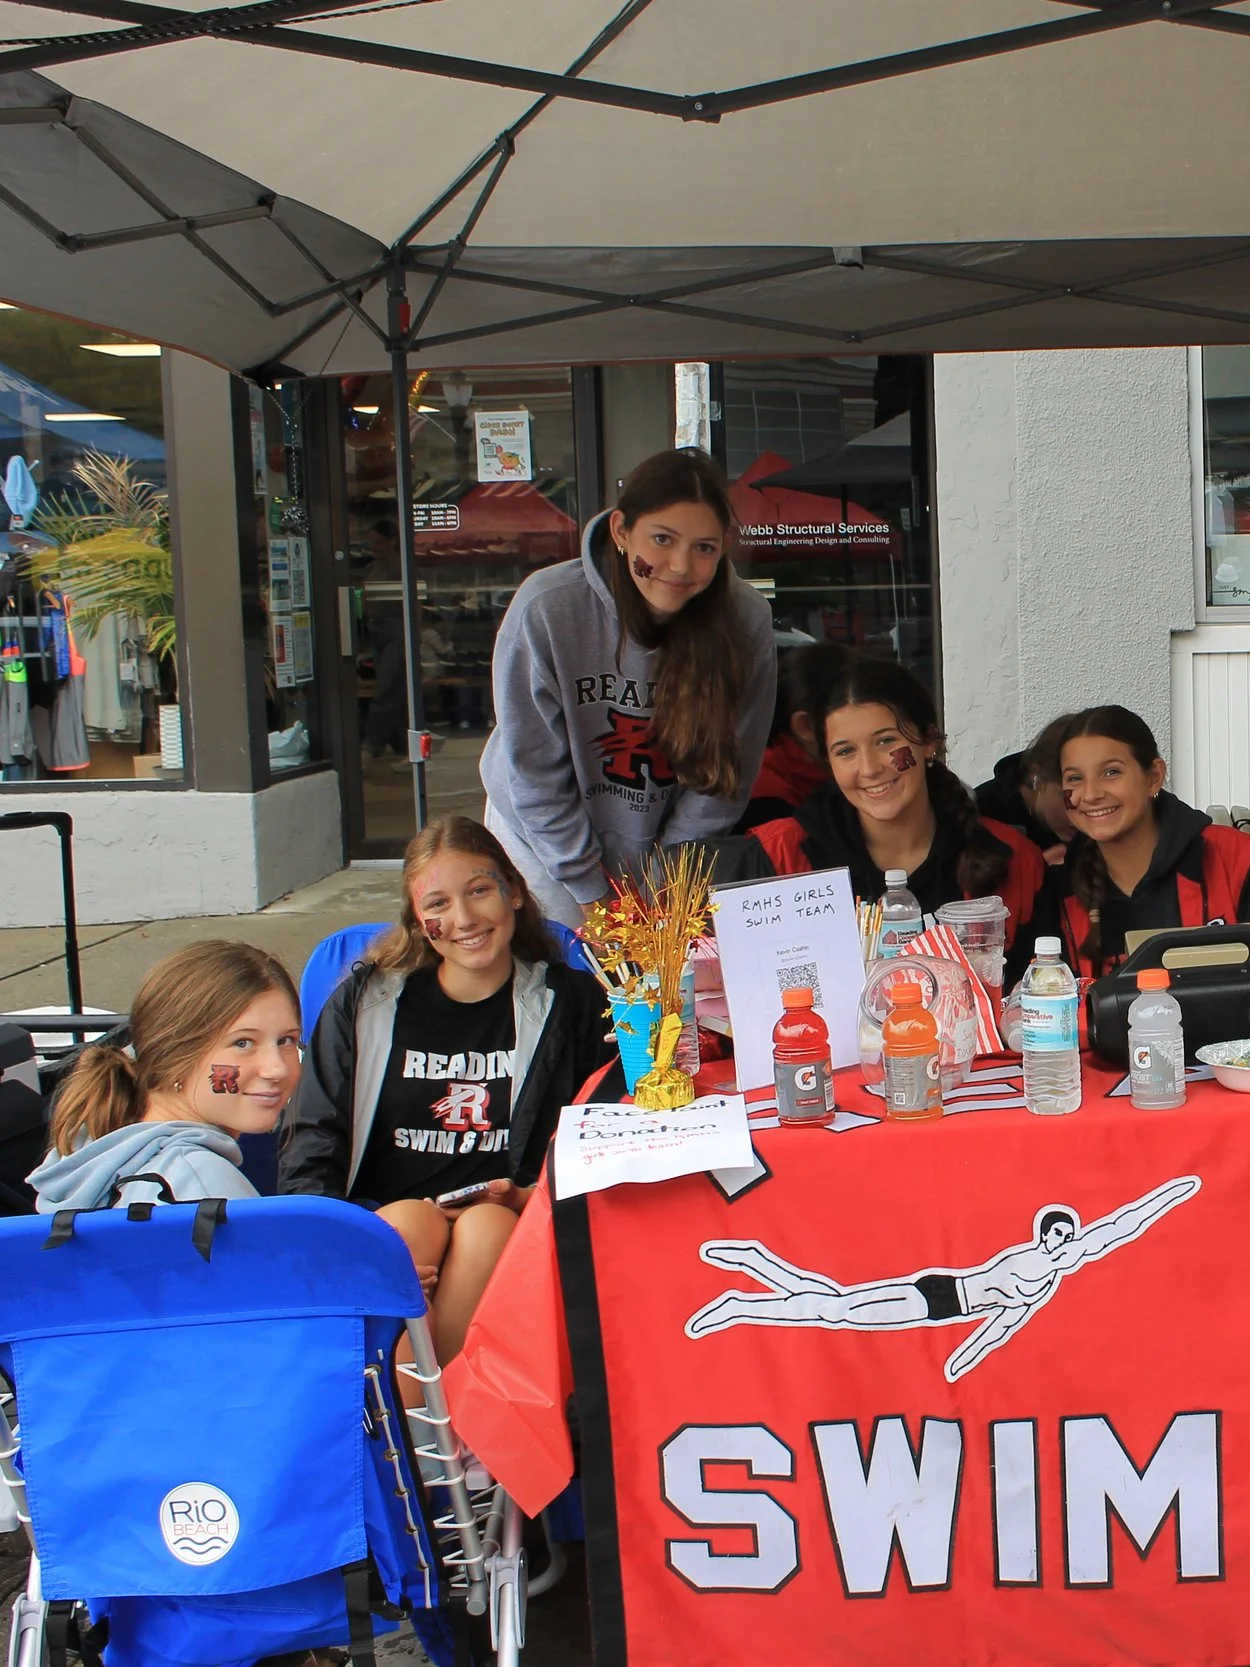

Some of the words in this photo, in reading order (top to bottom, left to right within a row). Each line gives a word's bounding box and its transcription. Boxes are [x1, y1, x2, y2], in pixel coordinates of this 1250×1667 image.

[739, 524, 773, 536] Webb
[776, 523, 835, 535] Structural
[838, 522, 890, 534] Services
[774, 537, 814, 547] Engineering
[815, 536, 838, 545] Design
[839, 536, 852, 544] and
[853, 535, 890, 544] Consulting
[585, 782, 645, 804] SWIMMING
[649, 793, 657, 803] &
[629, 802, 650, 812] 2023
[741, 894, 782, 913] RMHS
[793, 884, 835, 903] GIRLS
[745, 914, 782, 928] SWIM
[795, 902, 836, 918] TEAM
[776, 948, 791, 956] Kevin
[926, 1055, 939, 1081] G
[1133, 1045, 1151, 1069] G
[794, 1065, 818, 1091] G
[431, 1082, 491, 1131] R
[573, 1120, 620, 1129] for
[579, 1123, 718, 1140] Donation
[394, 1128, 456, 1155] SWIM
[459, 1131, 477, 1154] &
[658, 1410, 1225, 1599] SWIM
[173, 1523, 229, 1536] BEACH
